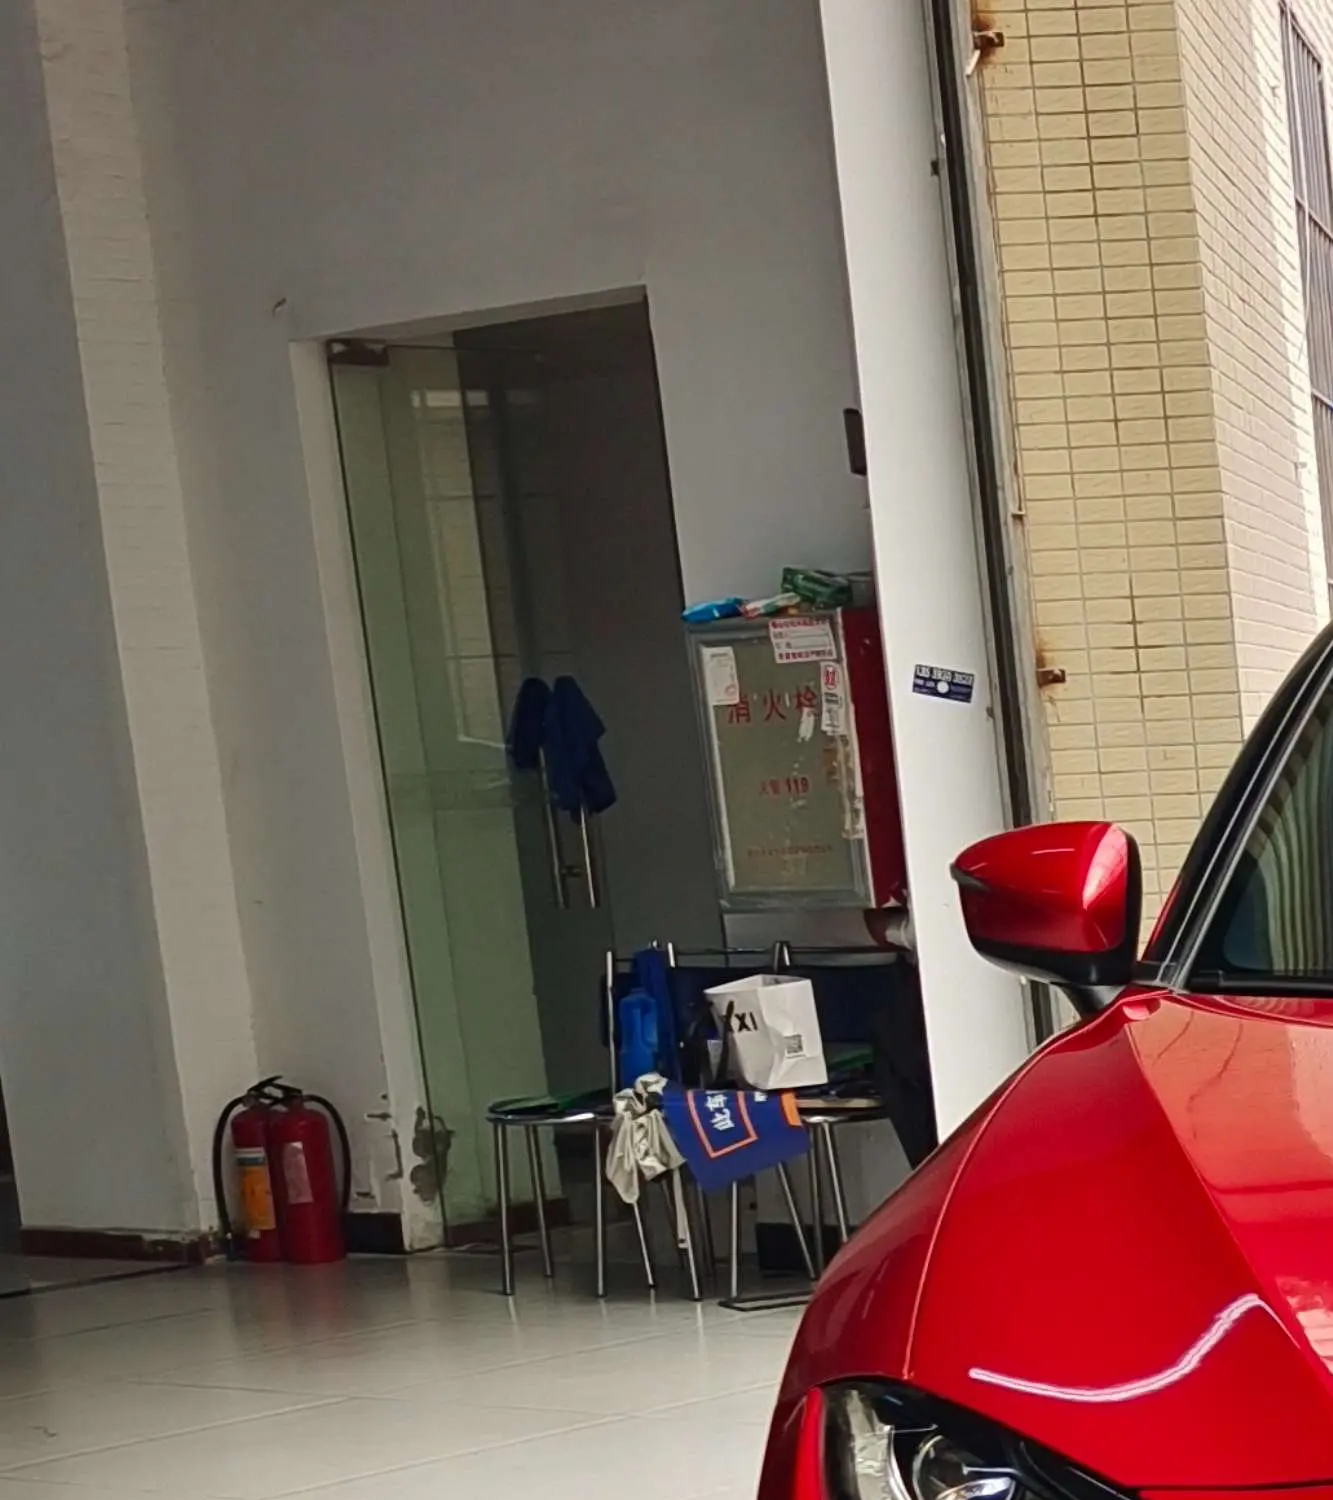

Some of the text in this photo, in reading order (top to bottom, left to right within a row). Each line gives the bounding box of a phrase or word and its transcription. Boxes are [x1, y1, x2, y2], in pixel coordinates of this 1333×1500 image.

[728, 685, 818, 724] 消火栓
[705, 1091, 735, 1132] 此车
